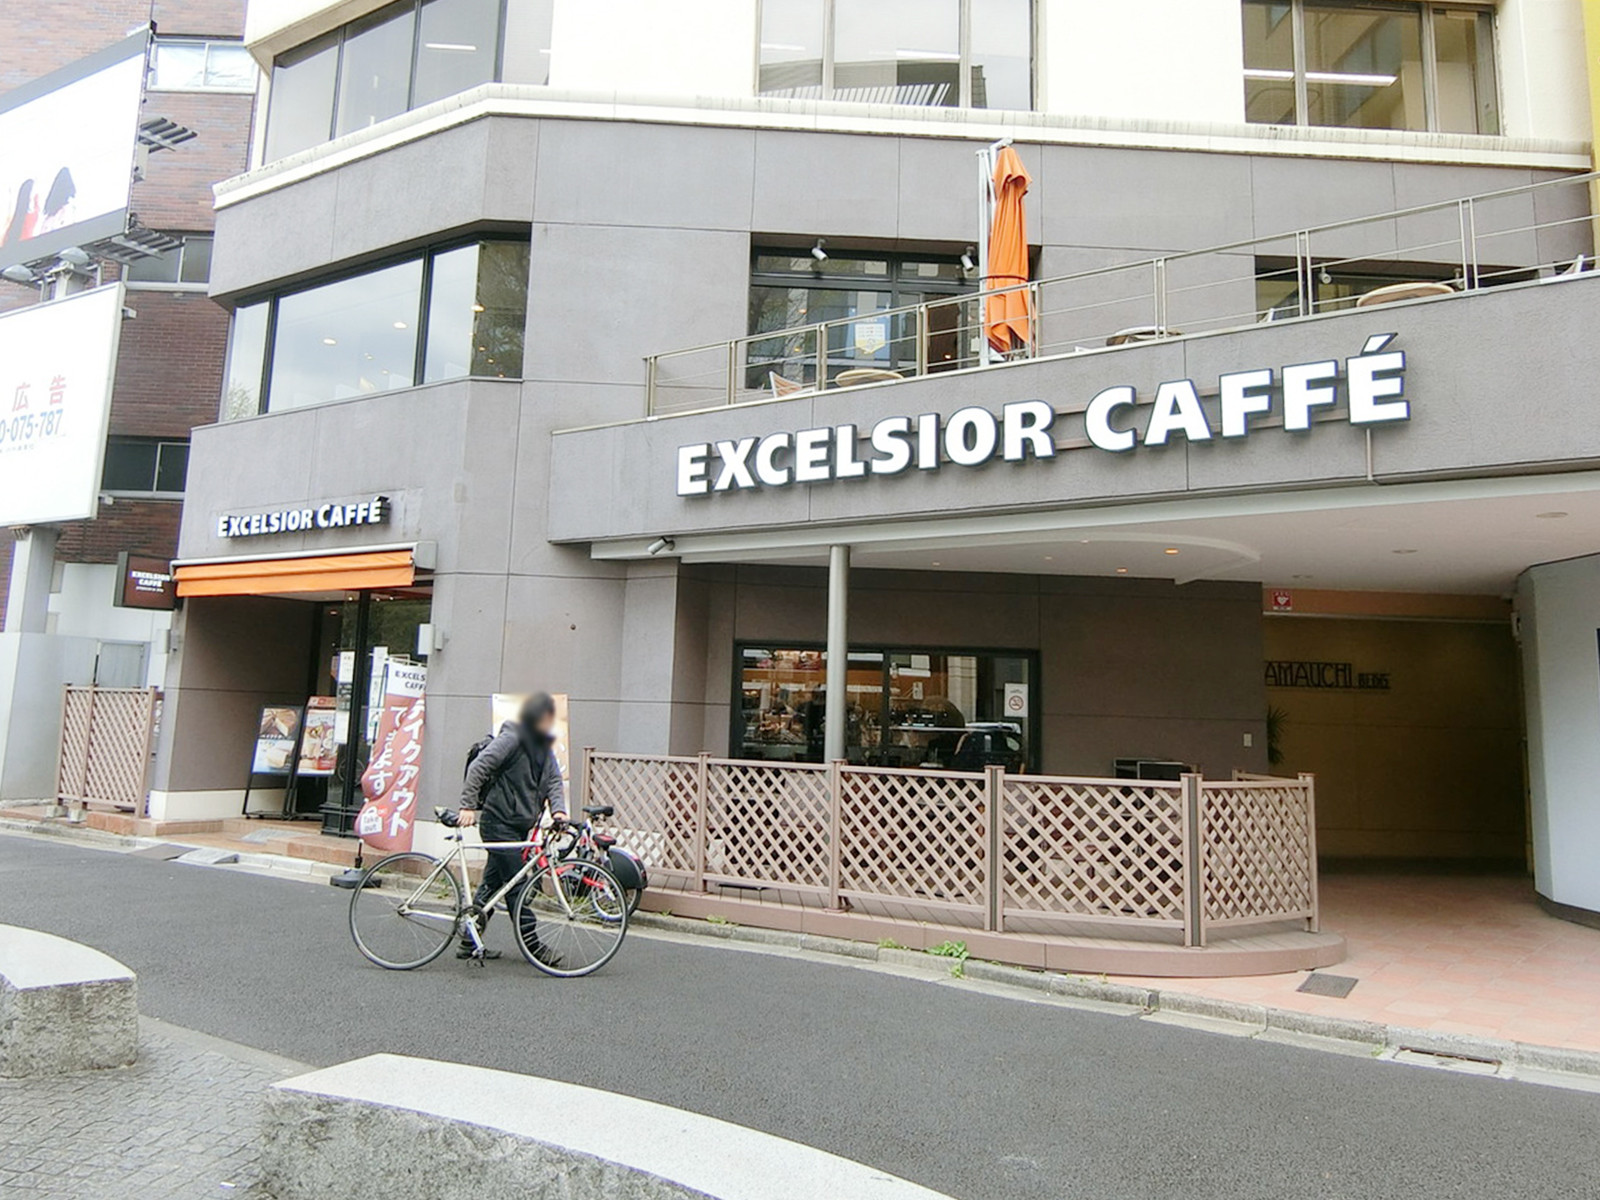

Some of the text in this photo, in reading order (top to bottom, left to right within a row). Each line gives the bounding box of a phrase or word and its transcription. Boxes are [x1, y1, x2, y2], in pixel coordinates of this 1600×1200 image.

[12, 374, 66, 412] 広告
[677, 332, 1411, 497] EXCELSIOR CAFFÉ
[217, 496, 384, 537] EXCELSIOR CAFFÉ
[389, 698, 425, 837] テイクアウト
